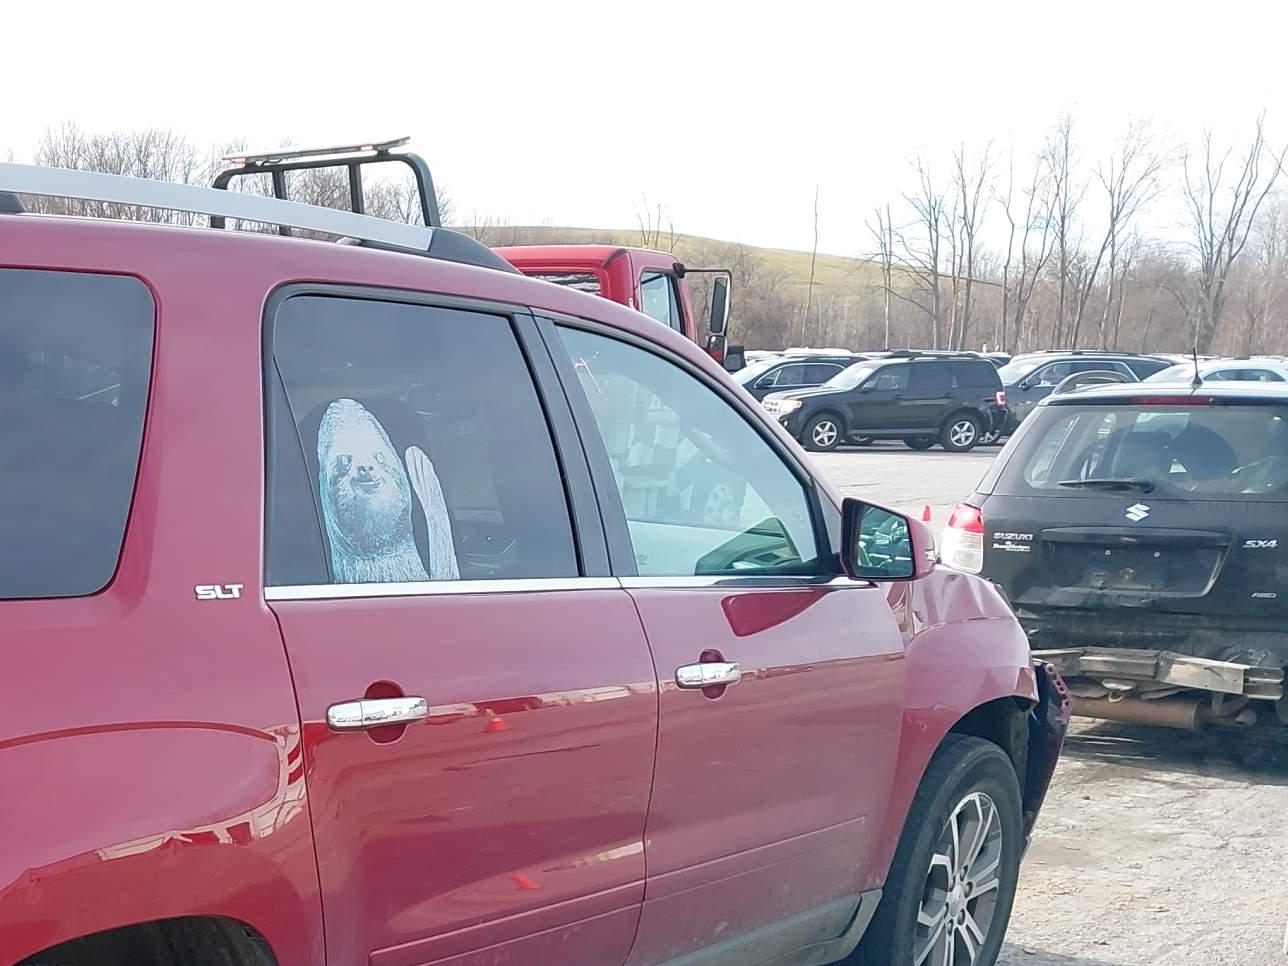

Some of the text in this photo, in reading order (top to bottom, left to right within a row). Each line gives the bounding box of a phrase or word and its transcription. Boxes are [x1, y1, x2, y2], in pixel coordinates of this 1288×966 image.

[993, 532, 1034, 541] SUZUKI
[1242, 539, 1279, 548] SX4
[195, 583, 244, 600] SLT
